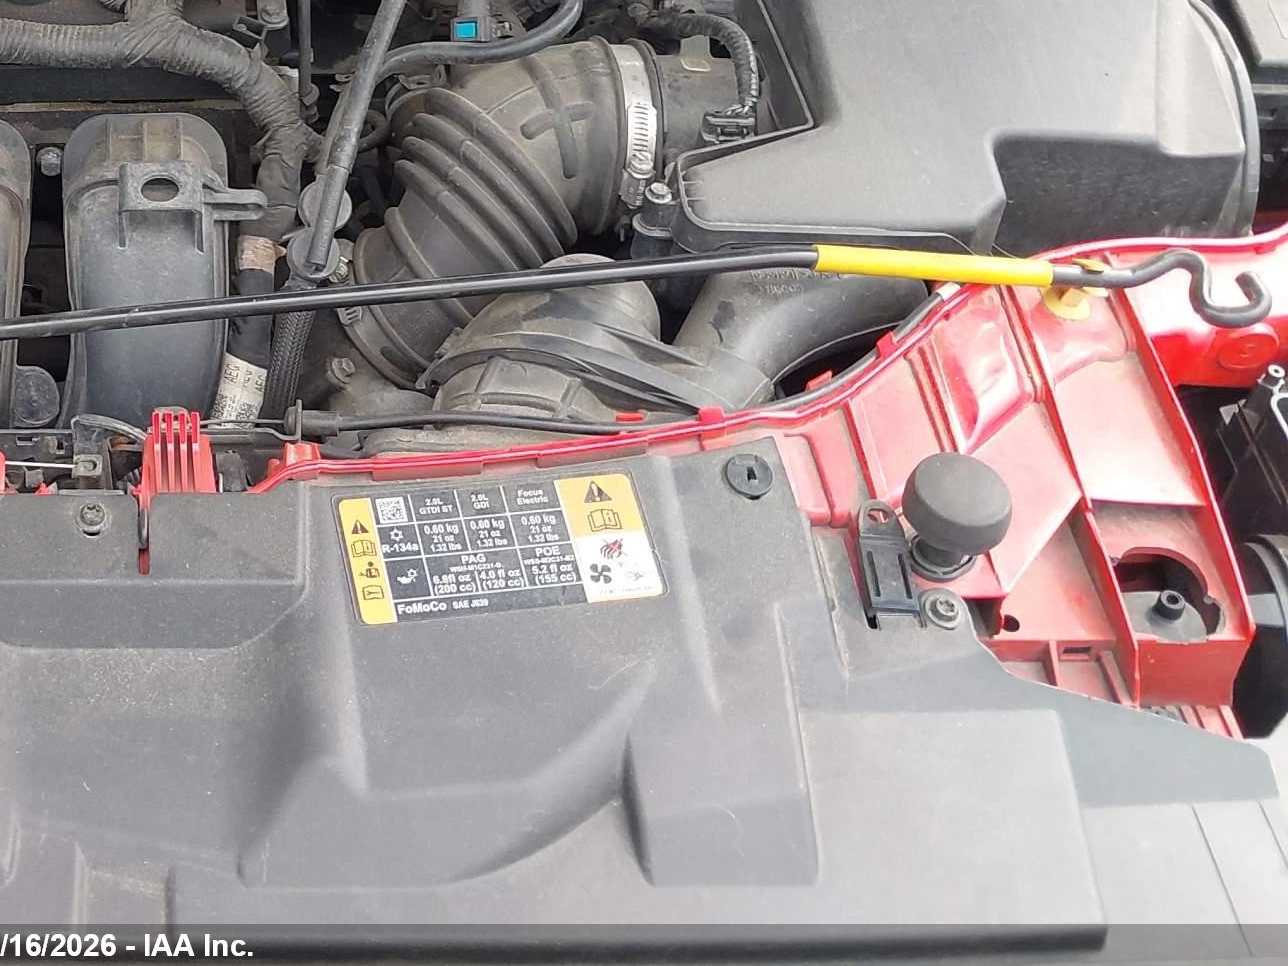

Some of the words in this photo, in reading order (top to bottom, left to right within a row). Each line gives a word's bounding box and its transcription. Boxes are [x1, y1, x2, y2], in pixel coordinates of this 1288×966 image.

[470, 494, 489, 502] 2.0L
[517, 490, 544, 498] Focus
[424, 498, 444, 506] 2.0L
[516, 496, 549, 506] Electric
[442, 504, 453, 512] ST
[470, 519, 490, 530] 0.60
[492, 518, 506, 530] kg
[520, 515, 542, 526] 0.60
[542, 514, 556, 525] kg
[424, 524, 445, 534] 0.60
[446, 523, 459, 534] kg
[530, 526, 540, 534] 21
[432, 535, 443, 543] 21
[444, 534, 454, 542] oz
[478, 530, 488, 538] 21
[528, 534, 546, 543] 1.32
[546, 534, 560, 542] lbs
[382, 542, 420, 554] R-134a
[448, 542, 463, 550] lbs
[476, 538, 494, 548] 1.32
[494, 538, 508, 546] lbs
[534, 546, 561, 557] POE
[460, 554, 486, 564] PAG
[532, 564, 548, 574] 5.2
[549, 564, 558, 574] fl
[560, 564, 573, 572] oz
[458, 574, 472, 582] oz
[480, 570, 496, 580] 4.0
[496, 569, 506, 578] fl
[507, 569, 521, 577] oz
[534, 574, 558, 586] (155
[560, 572, 576, 582] cc)
[482, 580, 506, 591] (120
[507, 576, 524, 588] cc)
[434, 584, 457, 596] (200
[458, 582, 476, 594] cc)
[396, 600, 448, 614] FoMoCo
[452, 598, 470, 610] SAE
